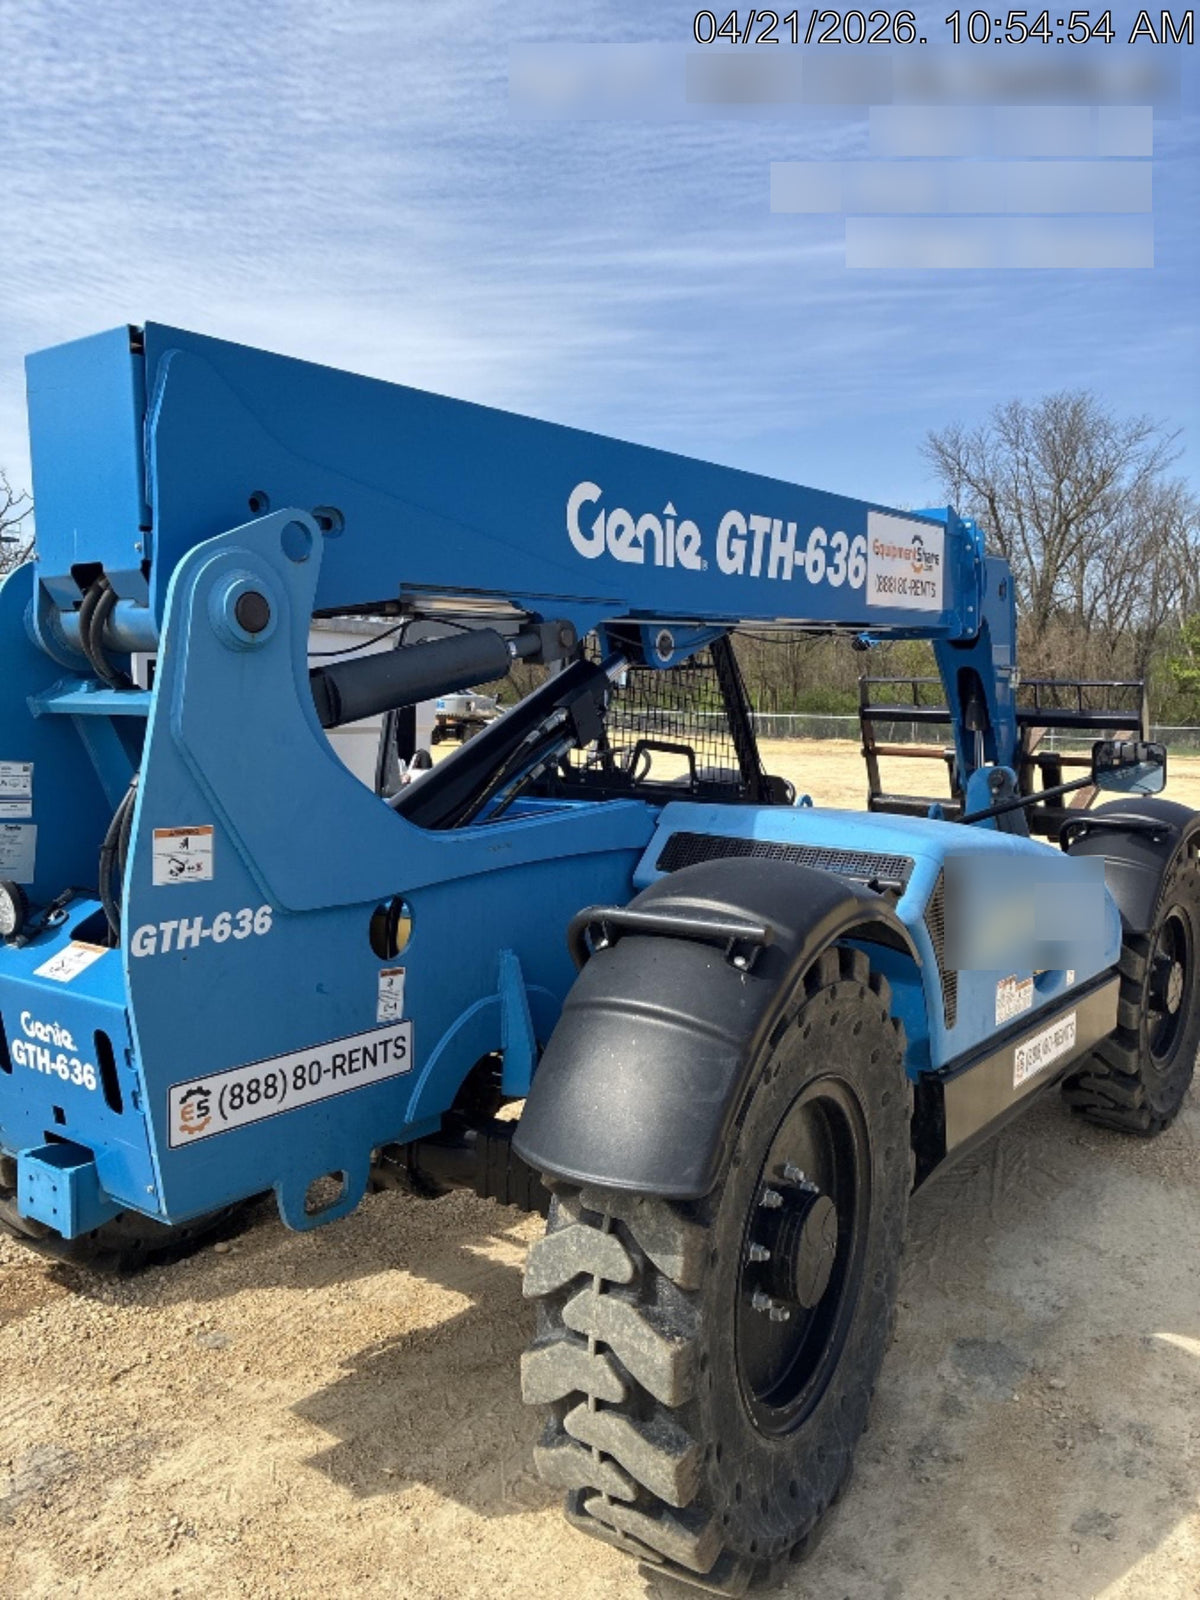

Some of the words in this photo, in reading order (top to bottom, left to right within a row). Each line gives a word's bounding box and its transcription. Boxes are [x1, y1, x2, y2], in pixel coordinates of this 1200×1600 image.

[566, 481, 703, 571] Genie
[716, 509, 868, 590] GTH-636
[130, 904, 273, 957] GTH-636
[20, 1010, 79, 1052] Genie
[11, 1039, 97, 1091] GTH-636
[218, 1068, 288, 1121] (888)
[292, 1035, 407, 1091] 80-RENTS
